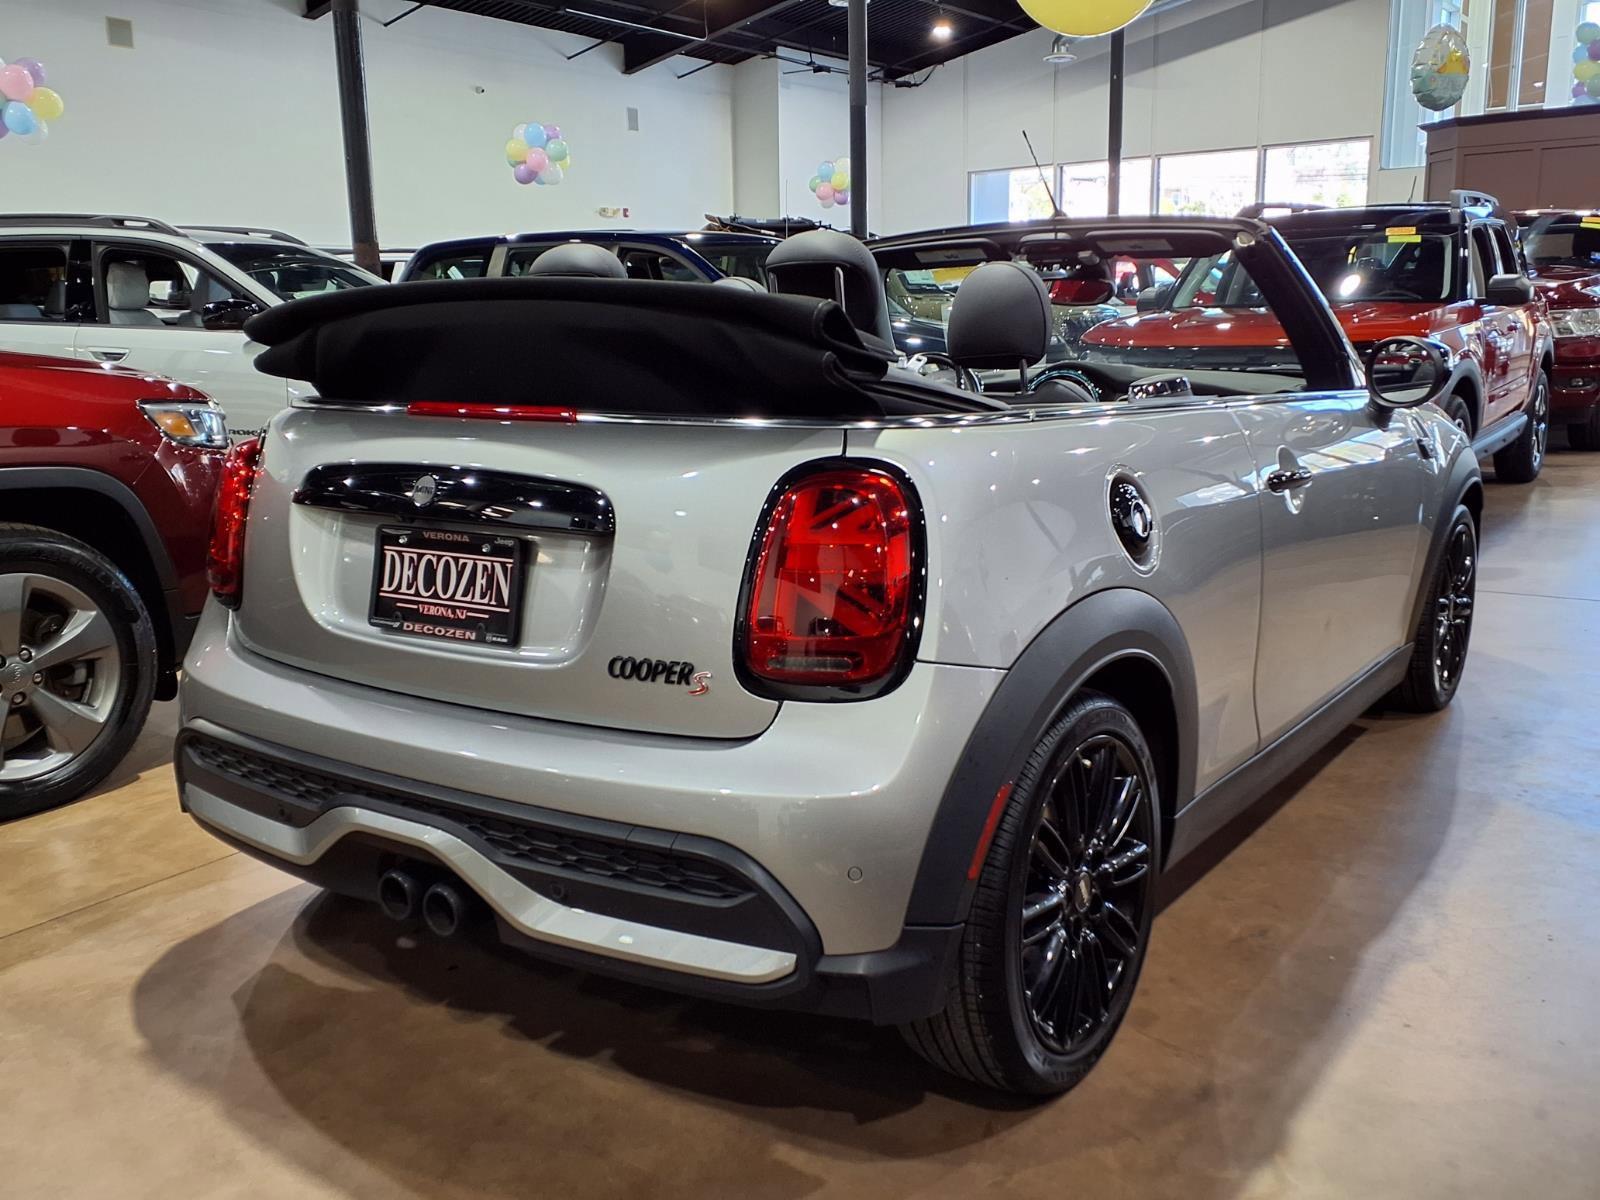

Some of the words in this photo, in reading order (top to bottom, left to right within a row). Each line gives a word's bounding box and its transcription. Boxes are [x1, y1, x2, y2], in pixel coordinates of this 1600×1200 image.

[415, 485, 434, 495] MINI
[422, 531, 470, 542] VERONA
[494, 537, 515, 547] Jeep
[380, 550, 513, 606] DECOZEN
[418, 604, 453, 620] VERONA,
[454, 609, 468, 620] NJ
[403, 622, 476, 640] DECOZEN
[608, 655, 694, 686] COOPER
[687, 671, 712, 696] S
